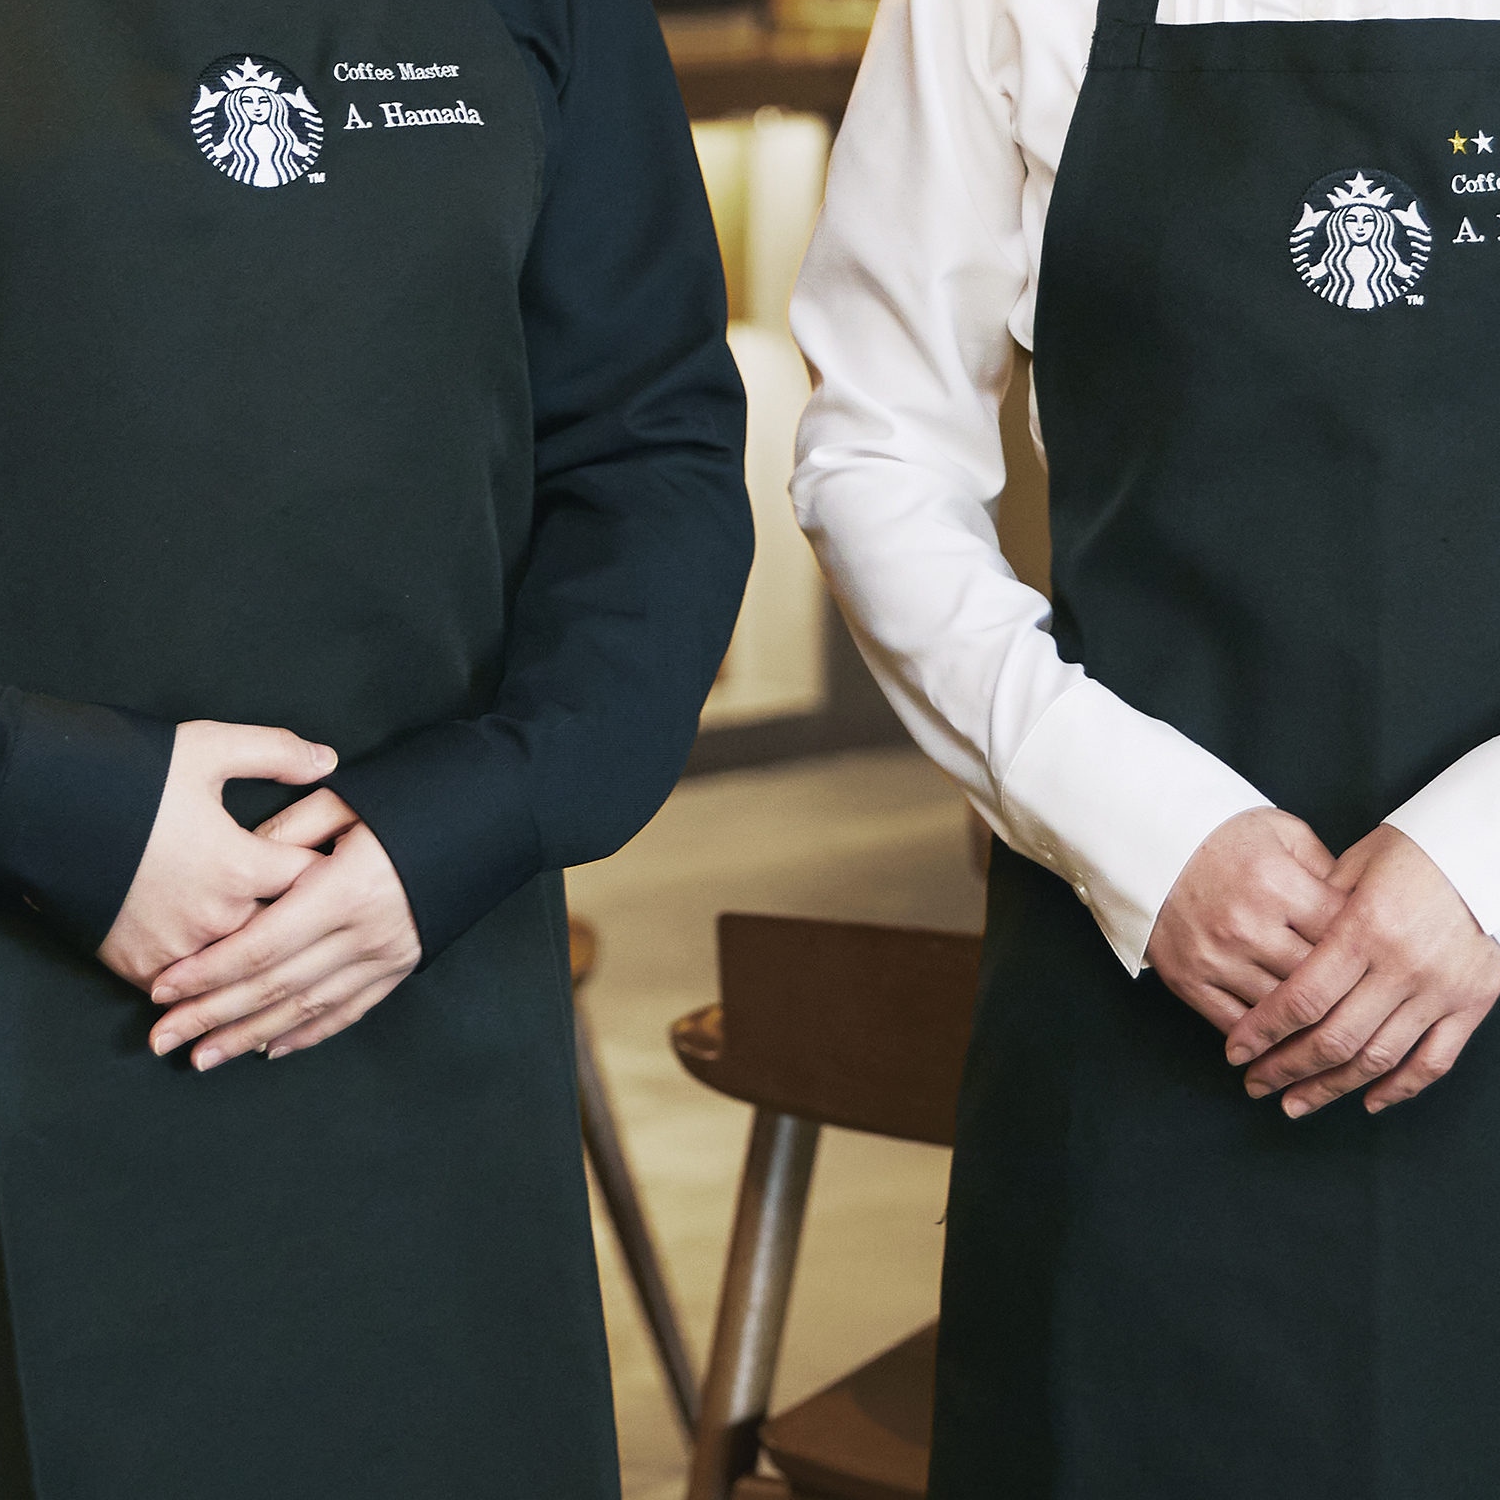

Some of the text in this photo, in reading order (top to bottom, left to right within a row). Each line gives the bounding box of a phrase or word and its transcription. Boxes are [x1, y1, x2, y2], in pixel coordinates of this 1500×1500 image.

[333, 62, 460, 82] Coffee Master
[343, 100, 485, 130] A. Hamada
[307, 172, 326, 184] TM
[1452, 216, 1485, 244] A.
[1404, 294, 1425, 306] TM
